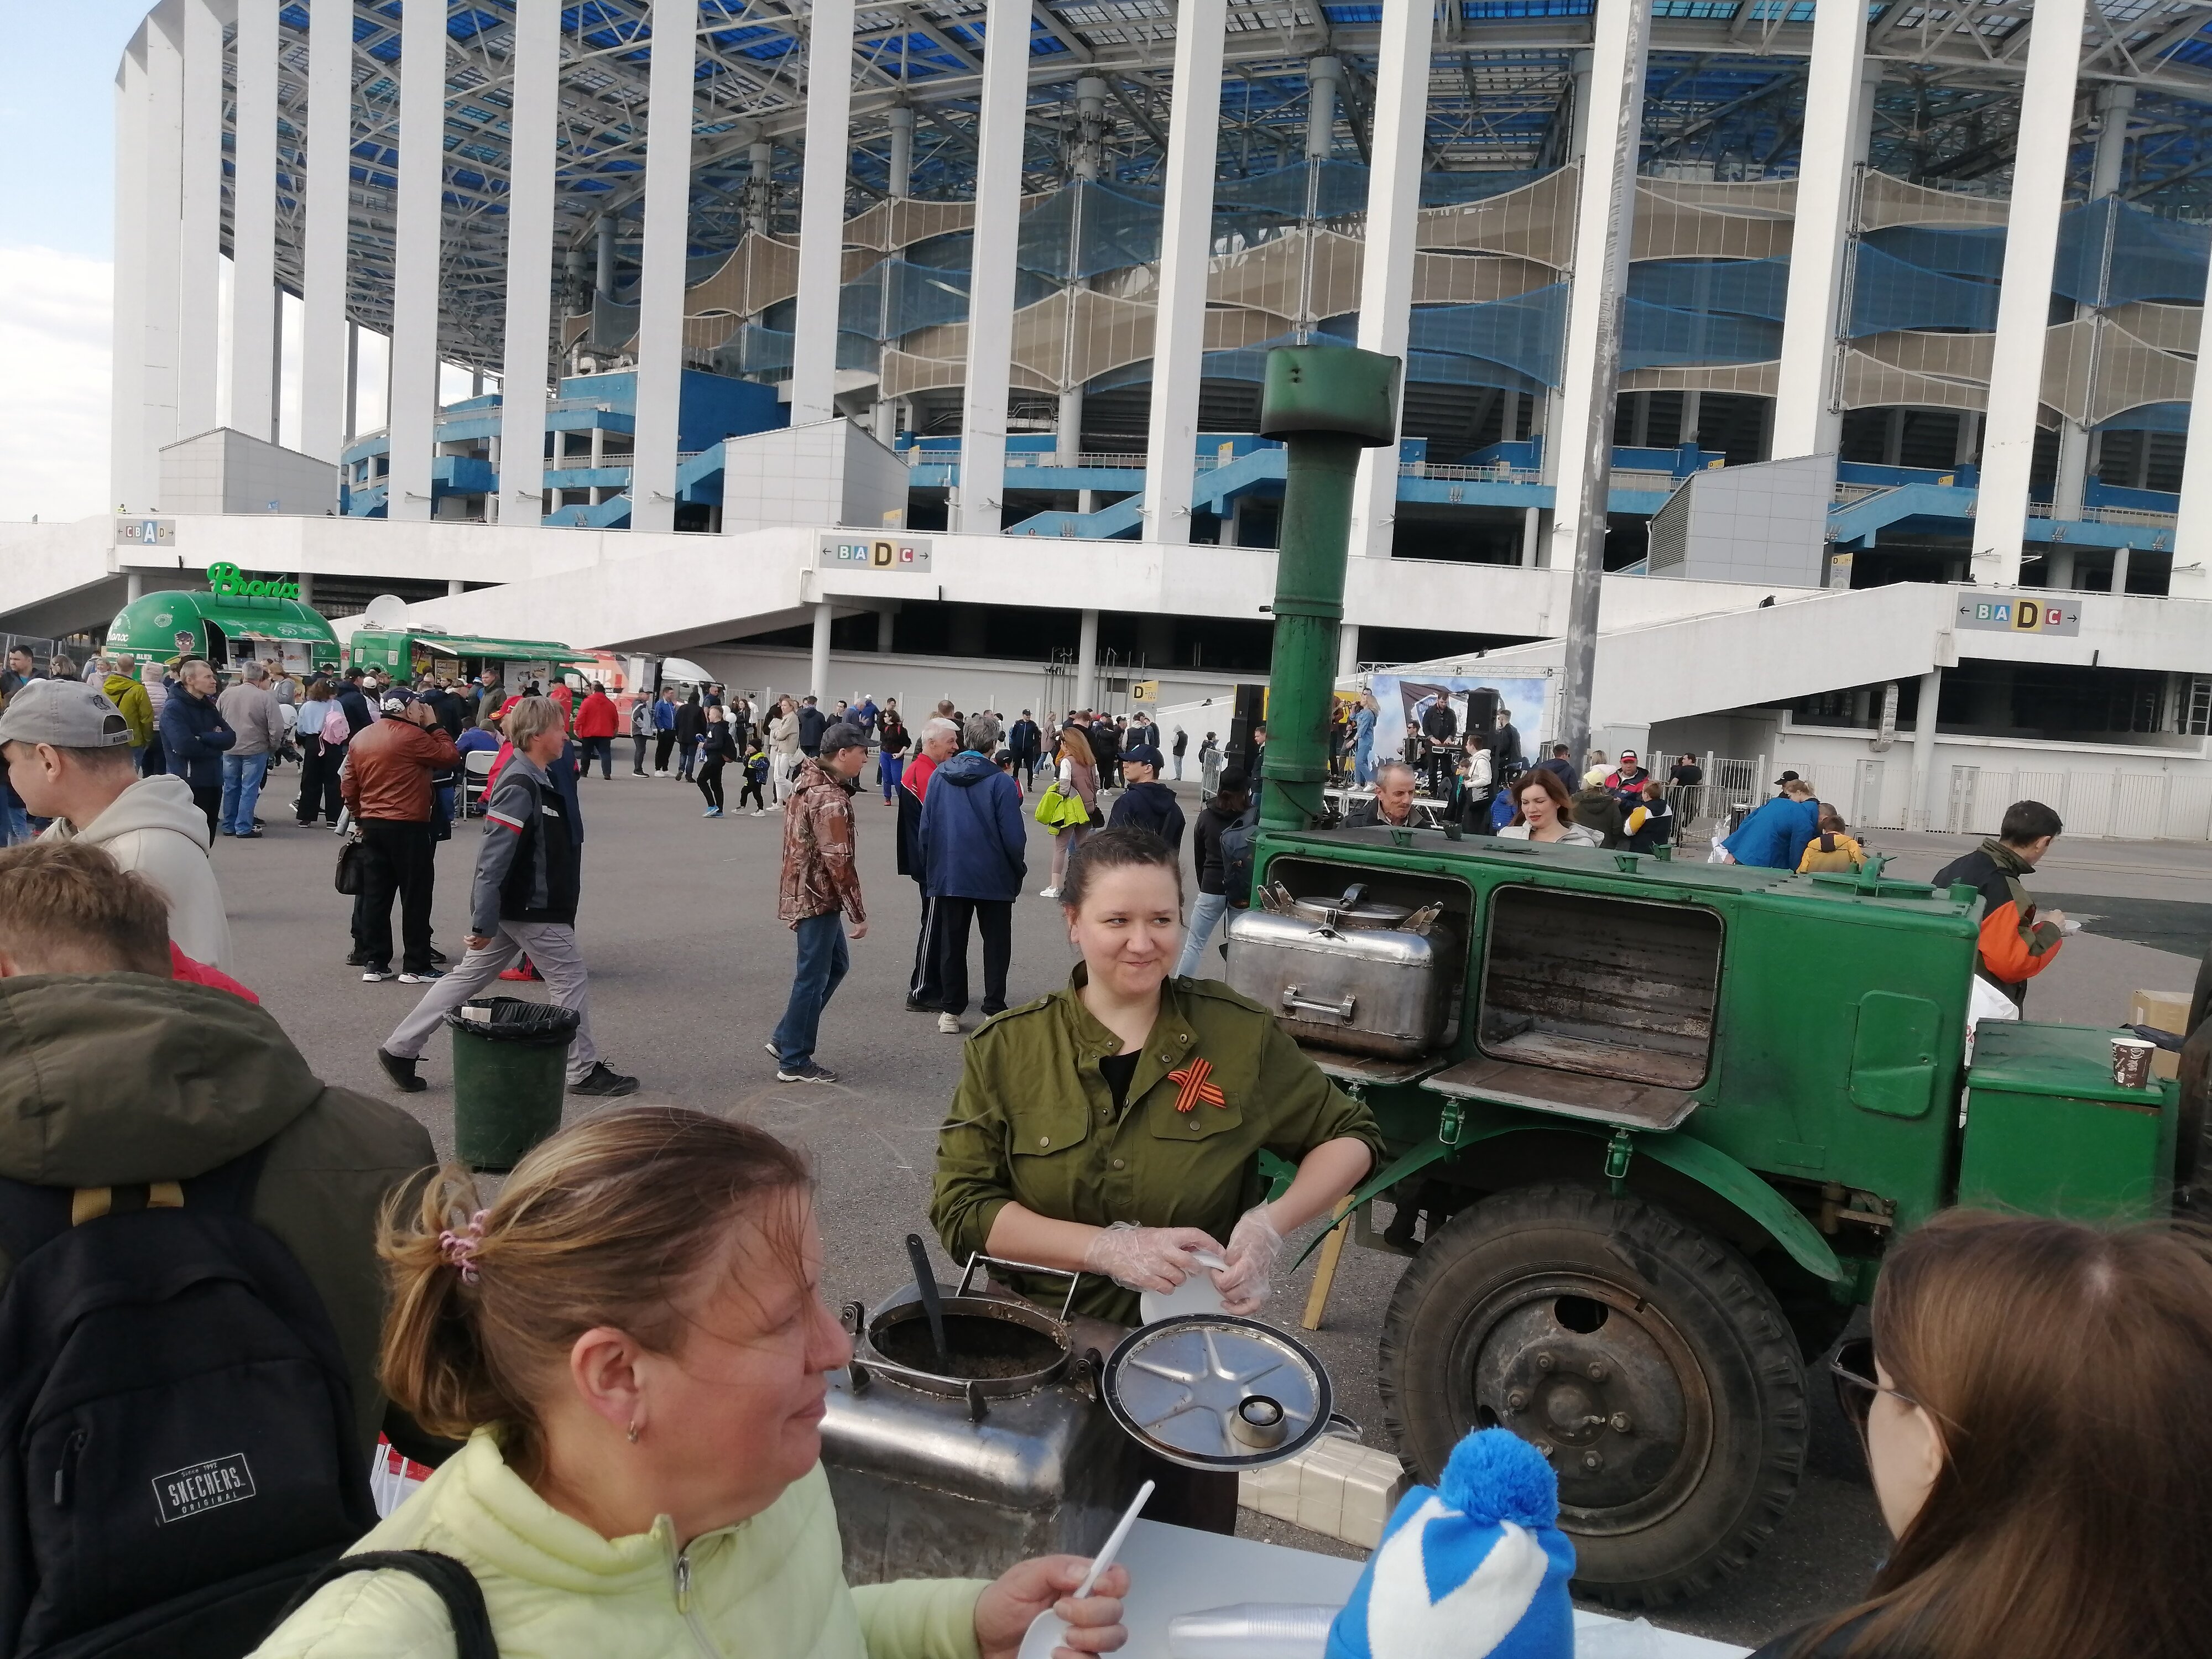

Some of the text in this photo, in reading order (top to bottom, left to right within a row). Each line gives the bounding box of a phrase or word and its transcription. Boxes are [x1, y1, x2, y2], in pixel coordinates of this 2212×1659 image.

[127, 522, 164, 542] C B A D
[839, 542, 911, 566] B A D C
[206, 561, 302, 599] Bronx
[1978, 601, 2059, 628] B A D C
[1134, 686, 1144, 698] D
[203, 1462, 218, 1471] 1992
[168, 1467, 242, 1506] SKECHERS
[181, 1491, 238, 1514] ORIGINAL
